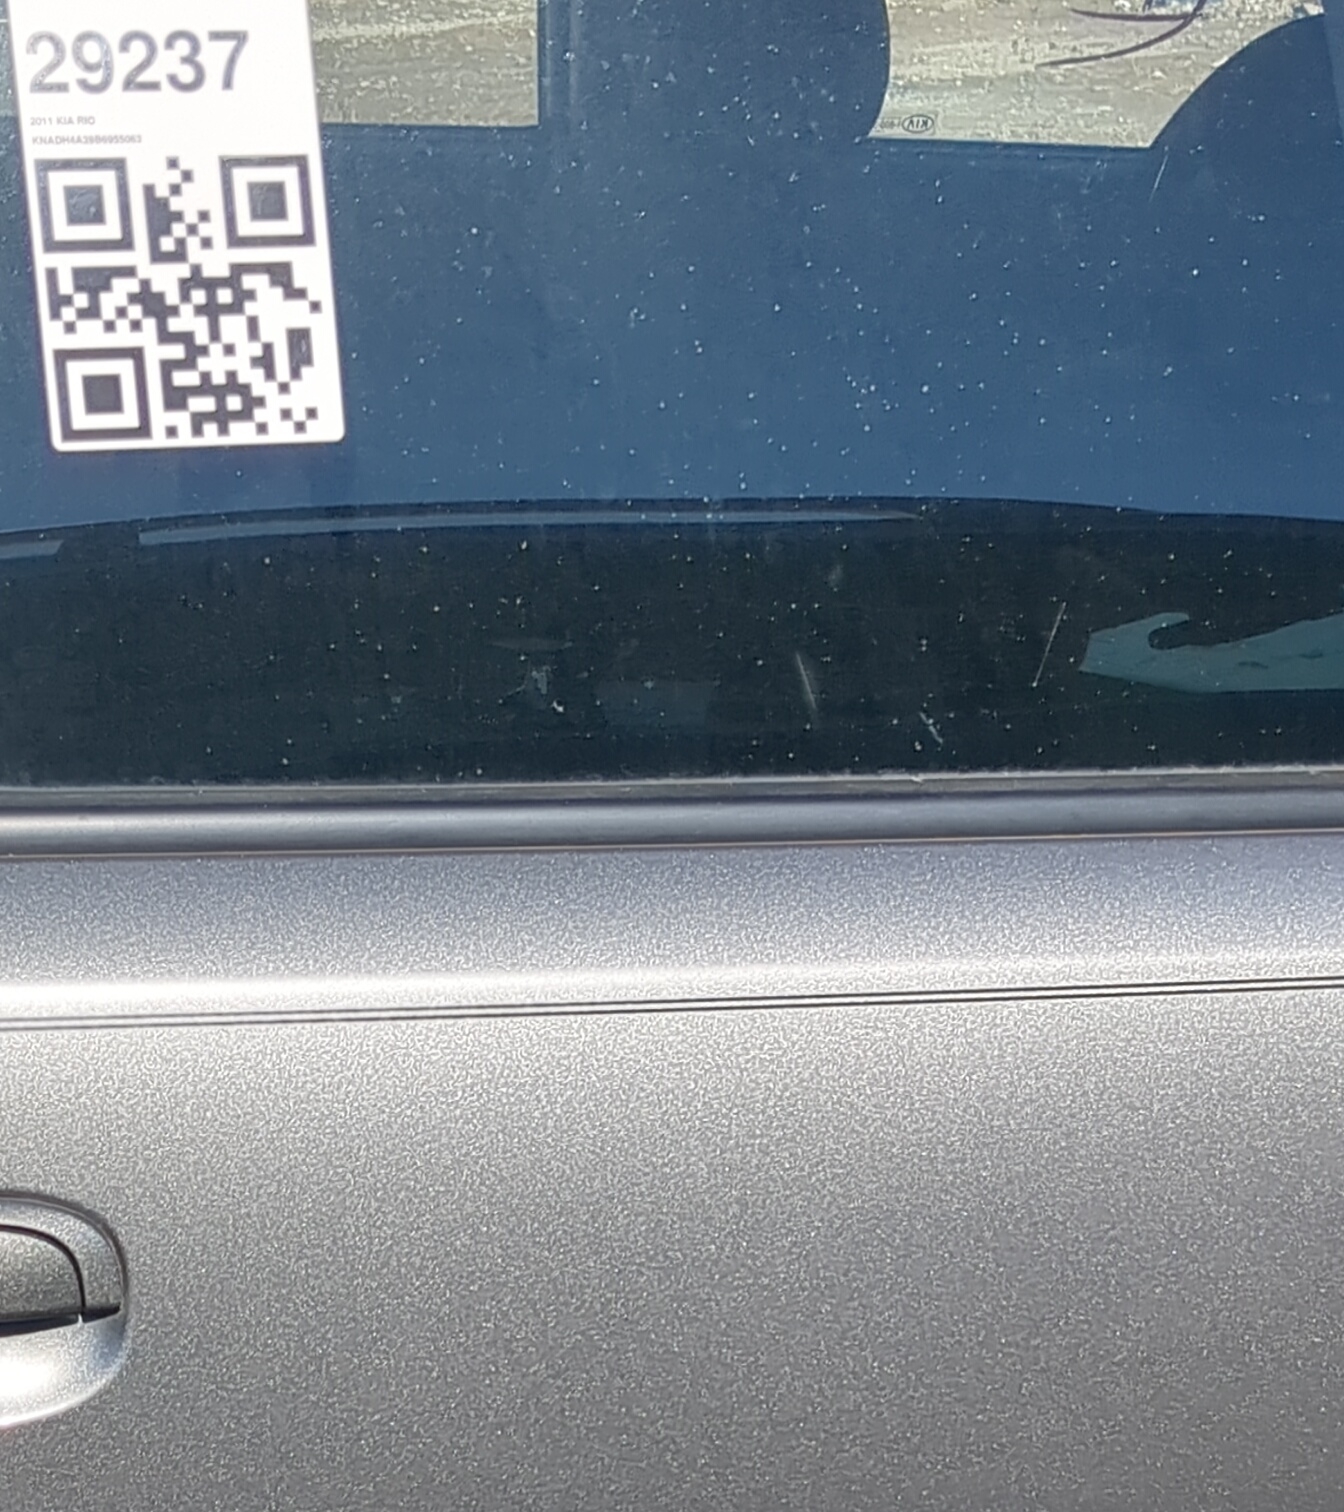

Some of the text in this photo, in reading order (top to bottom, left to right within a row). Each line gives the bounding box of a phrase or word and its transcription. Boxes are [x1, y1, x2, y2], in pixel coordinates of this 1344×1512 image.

[26, 29, 249, 95] 29237
[29, 115, 96, 126] 2011 KIA RIO
